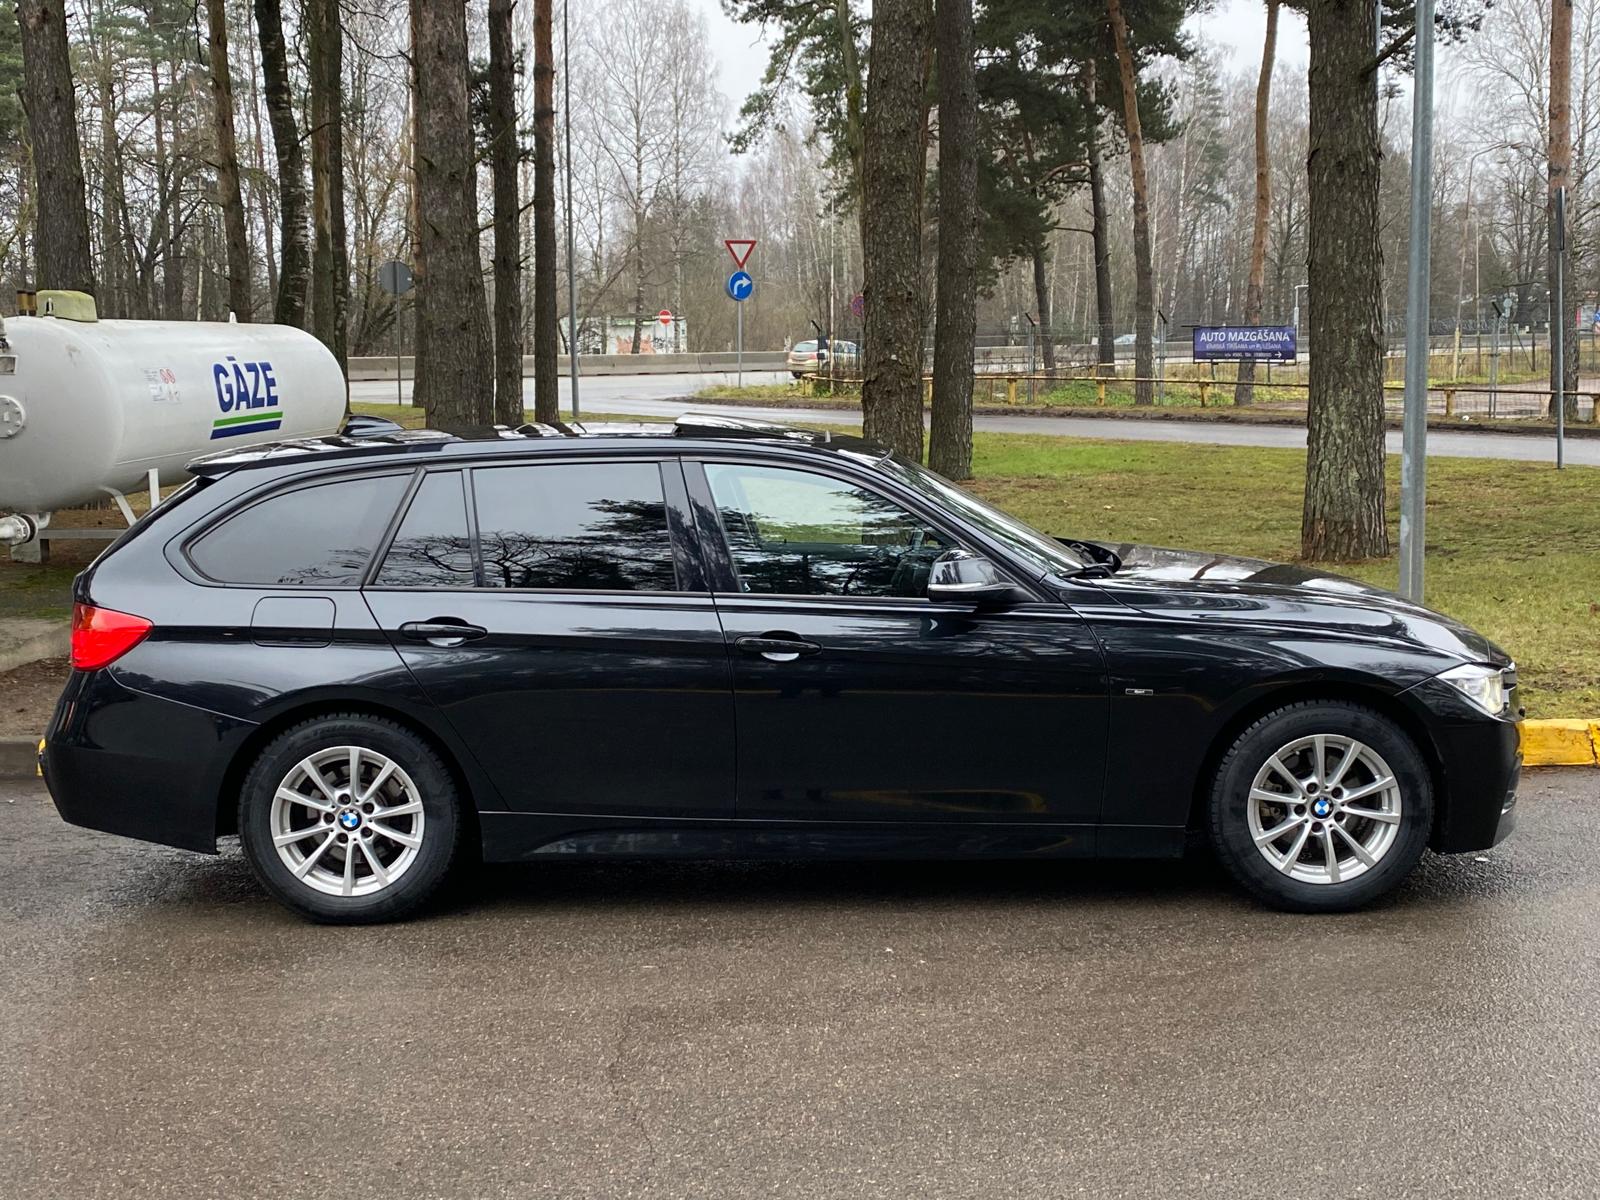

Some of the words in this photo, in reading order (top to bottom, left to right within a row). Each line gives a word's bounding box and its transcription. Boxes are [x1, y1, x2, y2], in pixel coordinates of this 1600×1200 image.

[1200, 332, 1226, 342] AUTO
[1228, 329, 1290, 342] MAZGĀŠANA
[213, 356, 279, 413] GĀZE
